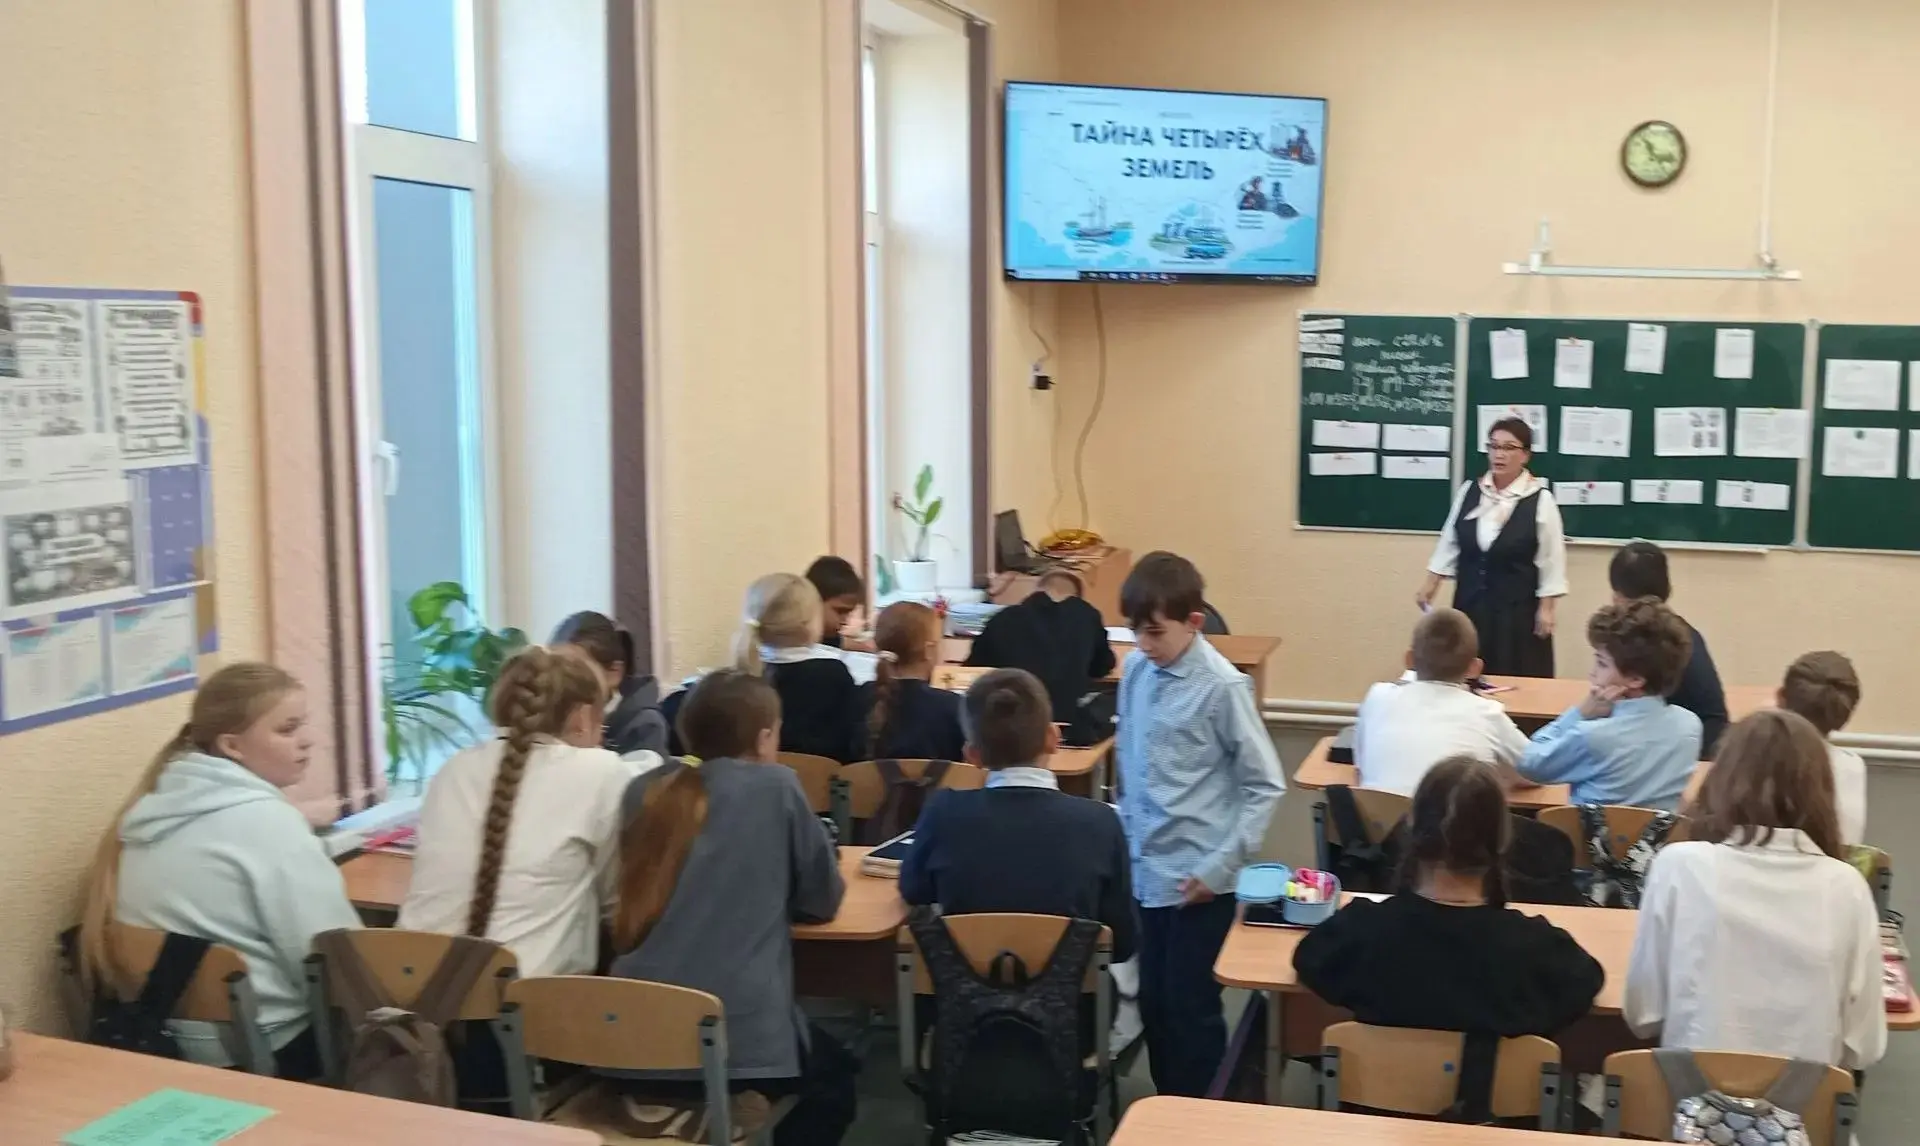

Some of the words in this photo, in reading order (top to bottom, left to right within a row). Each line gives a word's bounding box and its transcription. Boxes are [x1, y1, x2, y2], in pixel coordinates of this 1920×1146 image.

[1070, 120, 1154, 146] ТАЙНА
[1161, 126, 1264, 150] ЧЕТЫРЁХ
[1122, 157, 1215, 180] ЗЕМЕЛЬ
